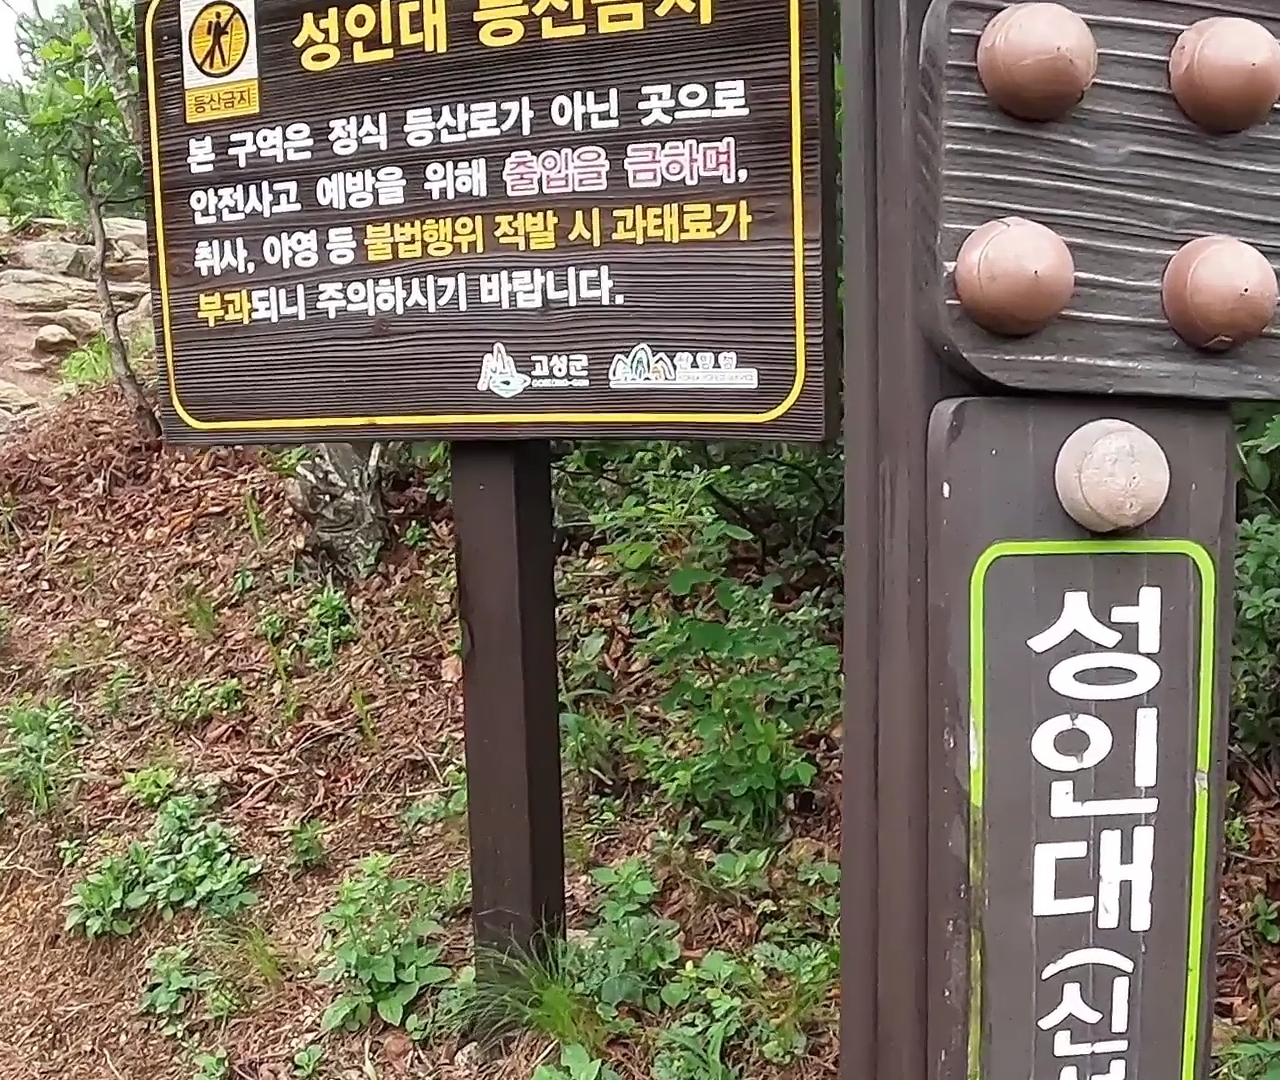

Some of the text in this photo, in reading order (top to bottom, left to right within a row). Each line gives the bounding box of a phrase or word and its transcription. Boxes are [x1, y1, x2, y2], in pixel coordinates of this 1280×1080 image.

[292, 0, 448, 72] 성인대
[186, 79, 750, 174] 본 구역은 정식 등산로가 아닌 곳으로
[194, 87, 251, 114] 등산금지
[189, 136, 748, 225] 안전사고 예방을 위해 출입을 금하며,
[194, 200, 752, 277] 취사, 야영 등 불법행위 적발 시 과태료가
[197, 265, 625, 327] 부과되니 주의하시기 바랍니다.
[531, 354, 588, 378] 고성군
